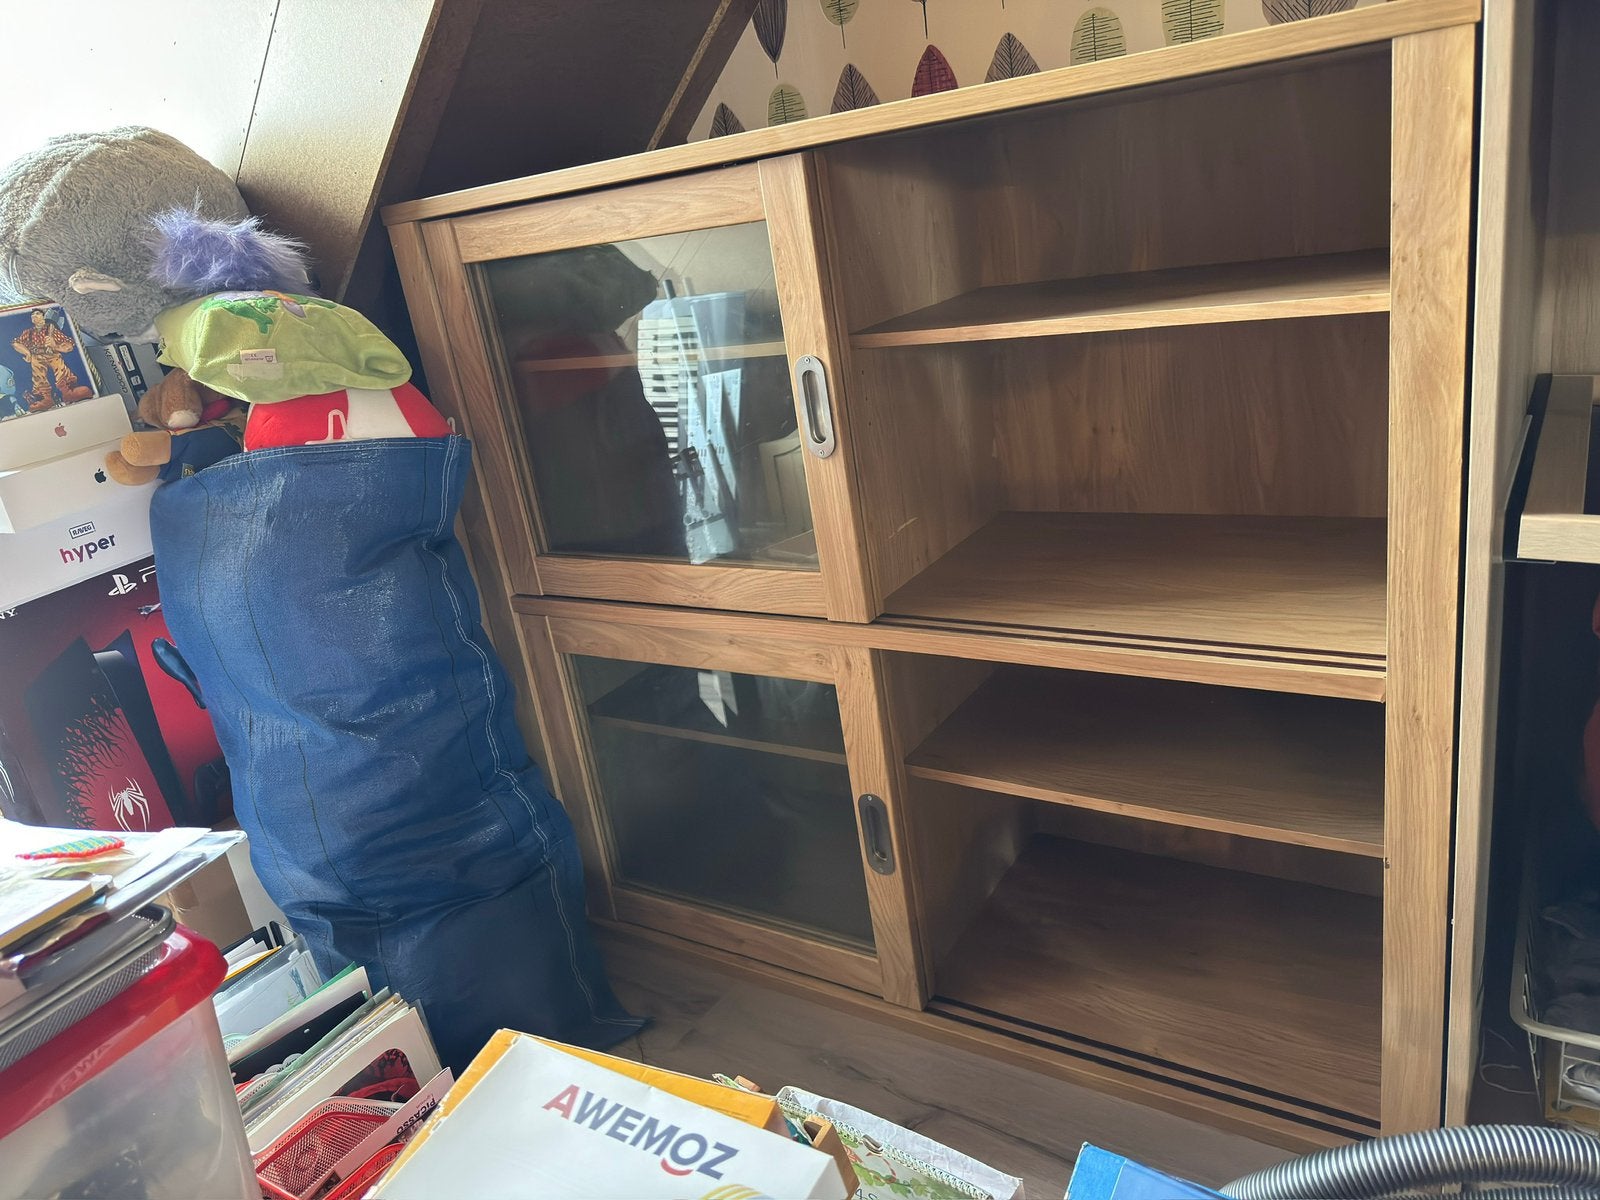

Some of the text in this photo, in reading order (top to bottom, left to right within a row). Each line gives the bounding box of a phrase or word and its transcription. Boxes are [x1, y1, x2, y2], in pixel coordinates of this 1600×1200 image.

[104, 348, 129, 394] KENWOOD
[59, 534, 116, 564] hyper
[396, 1097, 436, 1135] PICASSO
[542, 1084, 740, 1181] AWEMOZ
